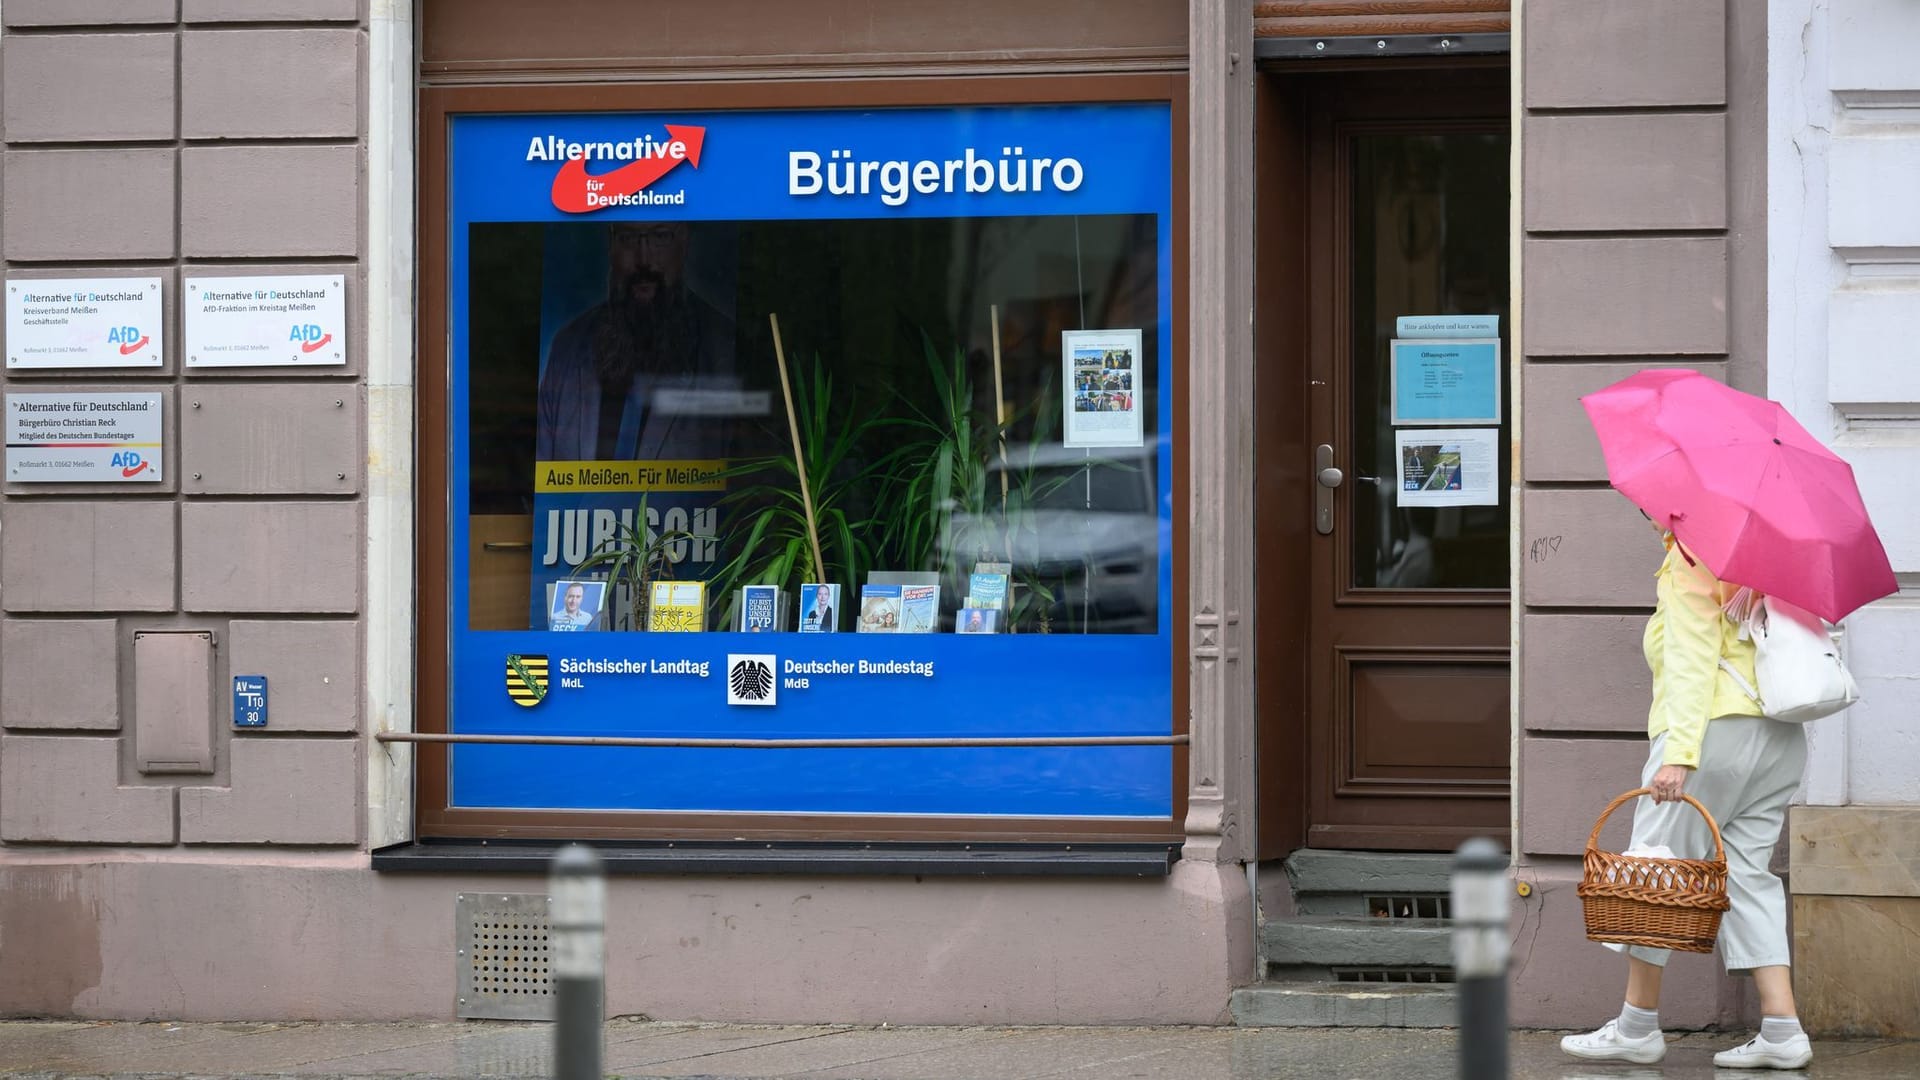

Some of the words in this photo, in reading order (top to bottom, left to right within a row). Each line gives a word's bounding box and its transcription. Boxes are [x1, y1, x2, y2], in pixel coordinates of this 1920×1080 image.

[526, 135, 687, 161] Alternative
[788, 148, 1084, 205] Bürgerbüro
[586, 180, 605, 191] für
[586, 190, 685, 206] Deutschland
[24, 293, 72, 302] Alternative
[74, 293, 87, 301] für
[89, 291, 143, 301] Deutschland
[203, 291, 252, 301] Alternative
[255, 291, 268, 299] für
[270, 289, 325, 299] Deutschland
[24, 307, 69, 315] Kreisverband
[71, 306, 98, 314] Meißen
[203, 305, 247, 313] AfD-Fraktion
[259, 304, 287, 313] Kreistag
[289, 303, 316, 311] Meißen
[24, 318, 69, 326] Geschäftsstelle
[108, 326, 140, 344] AfD
[289, 324, 322, 342] AfD
[19, 402, 71, 412] Alternative
[73, 402, 87, 412] für
[90, 401, 148, 412] Deutschland
[19, 419, 61, 428] Bürgerbüro
[63, 418, 96, 427] Christian
[99, 418, 116, 427] Reck
[19, 432, 45, 441] Mitglied
[46, 432, 57, 440] des
[59, 432, 92, 440] Deutschen
[94, 432, 135, 441] Bundestages
[73, 460, 95, 468] Meißen
[111, 452, 141, 468] AfD
[546, 469, 574, 486] Aus
[579, 468, 633, 485] Meißen.
[638, 467, 662, 485] Für
[748, 617, 772, 628] TYP
[560, 658, 647, 674] Sächsischer
[651, 659, 710, 678] Landtag
[784, 659, 855, 674] Deutscher
[858, 659, 934, 677] Bundestag
[236, 681, 248, 692] AV
[561, 678, 585, 688] MdL
[784, 678, 810, 689] MdB
[247, 711, 259, 722] 30
